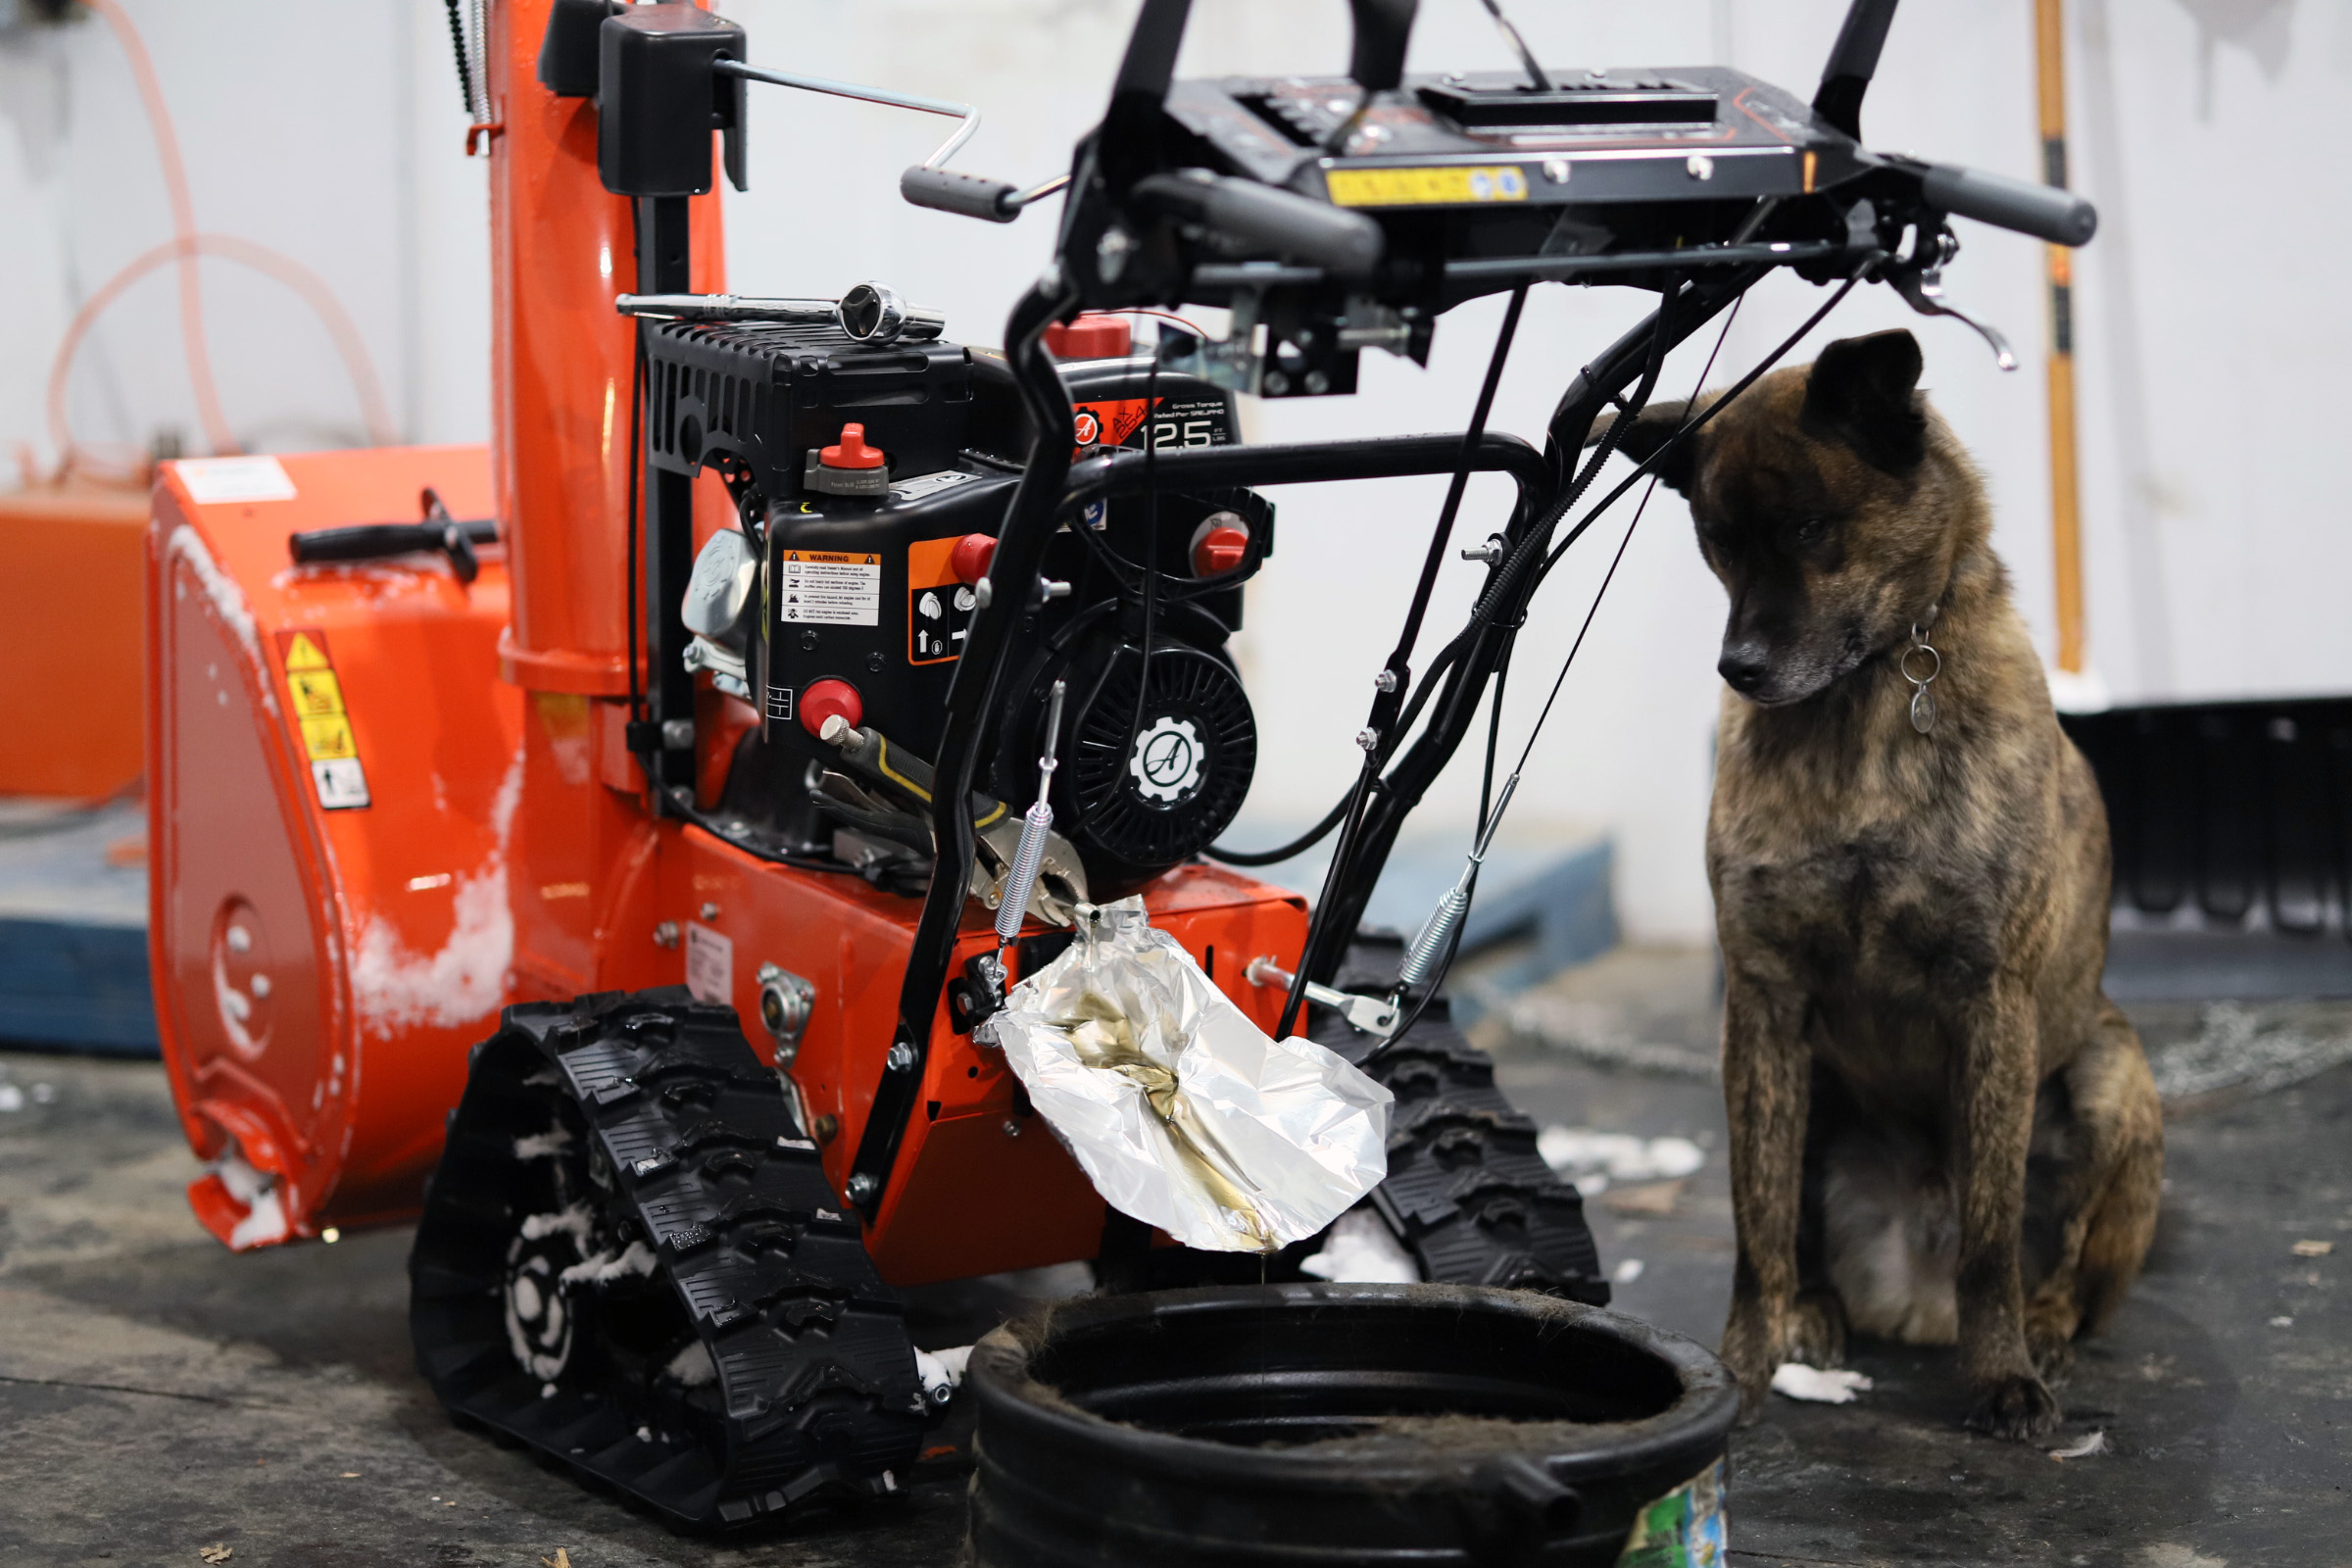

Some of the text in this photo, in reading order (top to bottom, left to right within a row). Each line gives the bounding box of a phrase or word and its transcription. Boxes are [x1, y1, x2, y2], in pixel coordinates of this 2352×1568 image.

[1112, 408, 1131, 430] AX
[1116, 406, 1146, 439] 254
[1140, 420, 1211, 451] 12.5
[809, 554, 850, 563] WARNING
[1146, 737, 1183, 776] A
